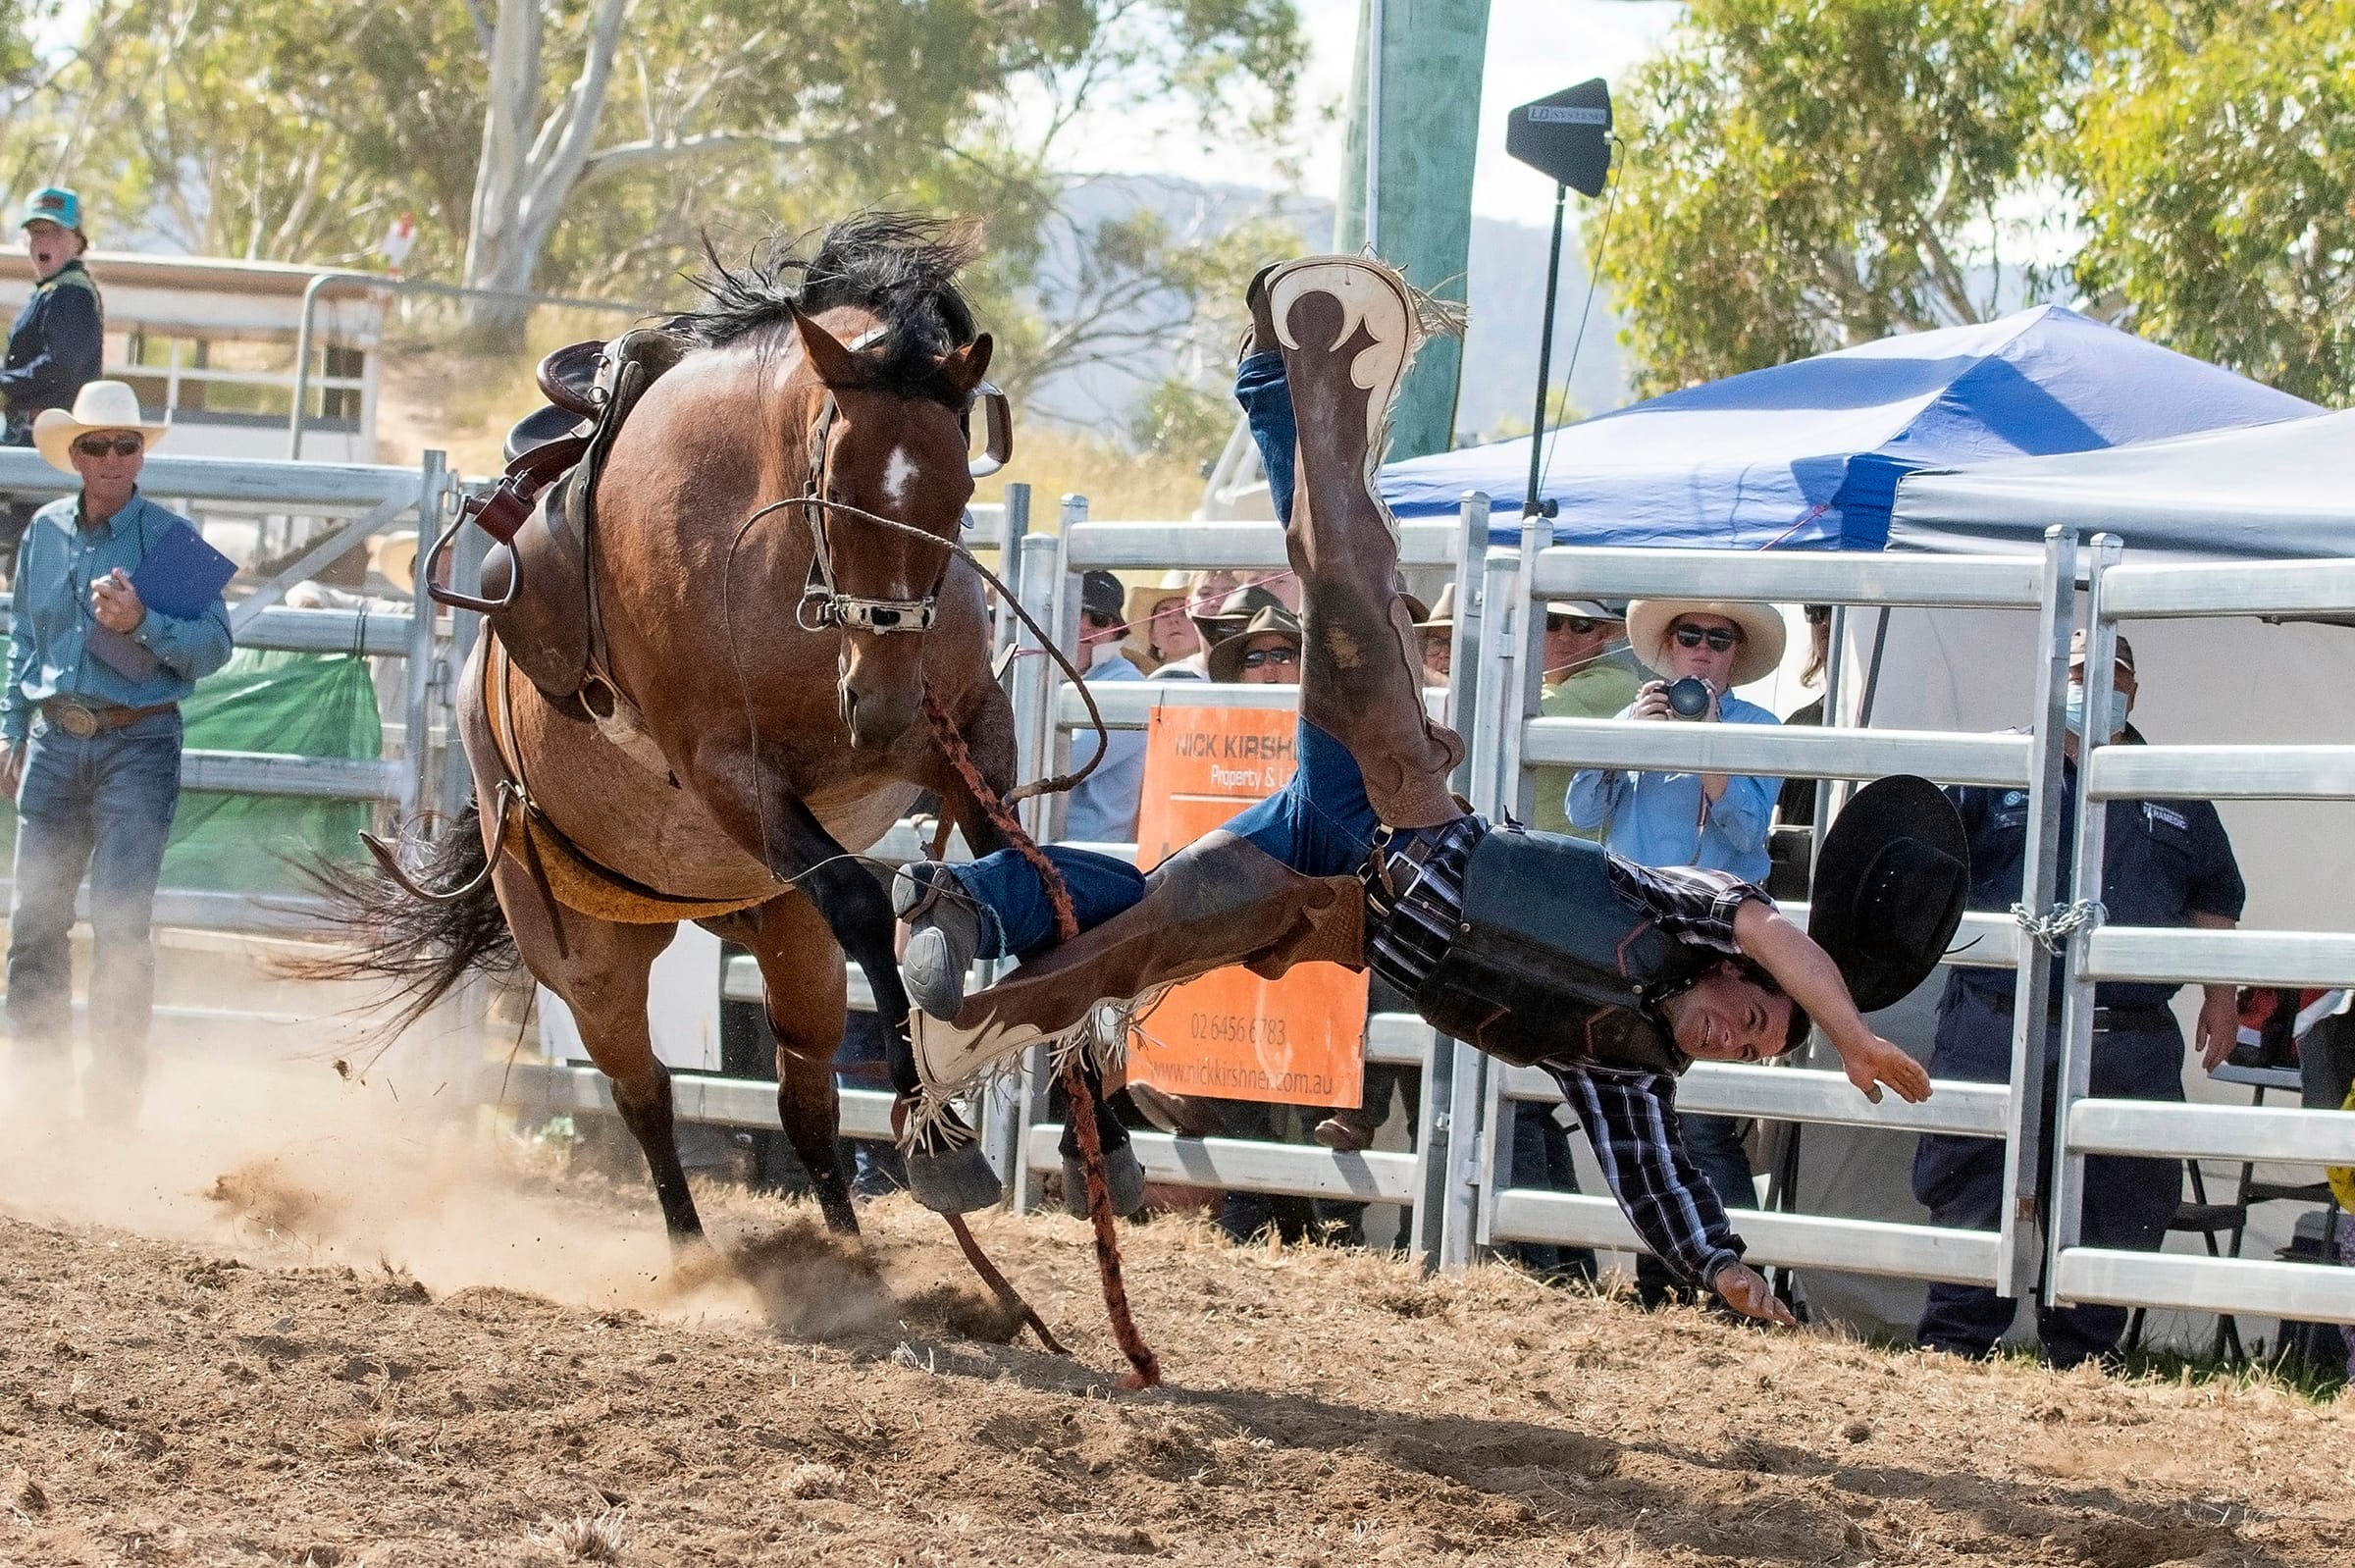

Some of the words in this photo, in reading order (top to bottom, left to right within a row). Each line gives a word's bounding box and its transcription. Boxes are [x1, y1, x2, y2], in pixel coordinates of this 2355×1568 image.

[1531, 108, 1549, 120] LD
[1176, 734, 1217, 757] NICK
[1225, 735, 1297, 760] KIRSH
[1211, 764, 1262, 791] Property
[1265, 766, 1276, 787] &
[1191, 1014, 1207, 1038] 02
[1211, 1015, 1246, 1042] 6456
[1249, 1019, 1285, 1045] 6783
[1151, 1060, 1333, 1095] www.nickkirshner.com.au
